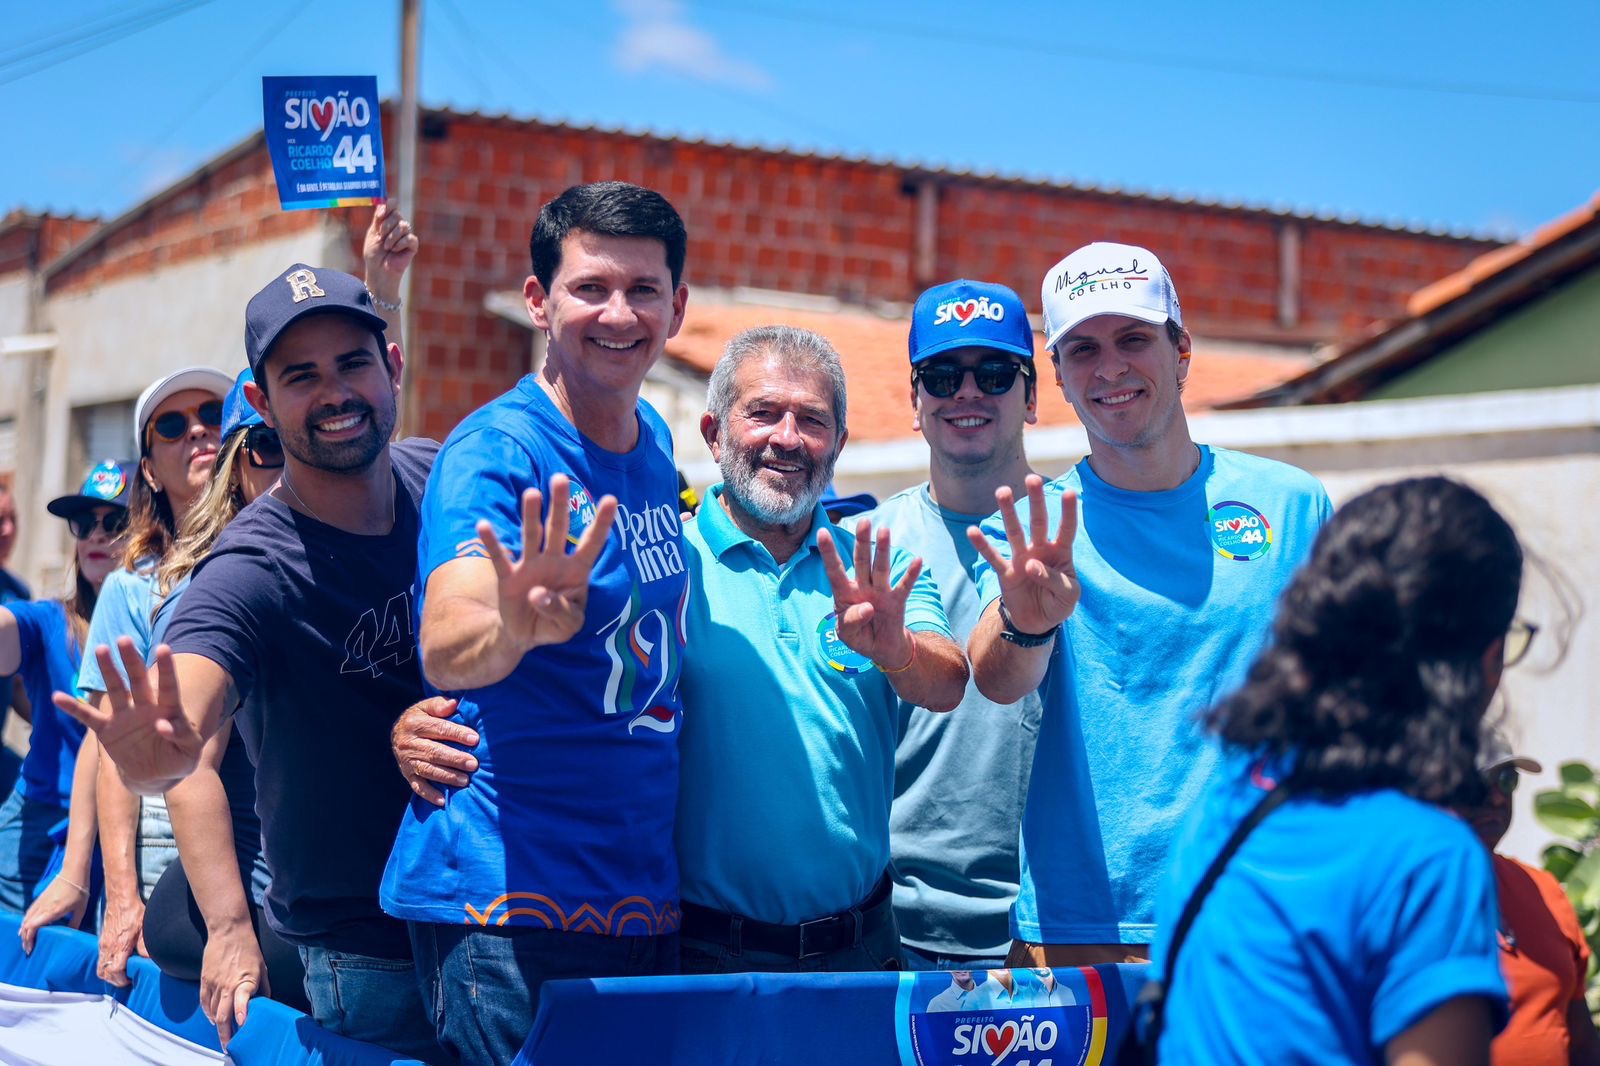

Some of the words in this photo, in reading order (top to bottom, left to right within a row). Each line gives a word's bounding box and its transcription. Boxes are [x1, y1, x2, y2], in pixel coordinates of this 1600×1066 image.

[288, 145, 333, 158] RICARDO
[290, 158, 332, 171] COELHO
[333, 134, 377, 174] 44
[286, 269, 326, 304] R
[1055, 259, 1148, 293] Miguel
[1069, 281, 1132, 300] COELHO
[934, 296, 1004, 327] SIMÃO
[614, 500, 679, 550] Petro
[1215, 515, 1259, 534] SIMÃO
[1241, 529, 1264, 544] 44
[631, 539, 685, 584] lina
[952, 1014, 1058, 1066] SIMÃO
